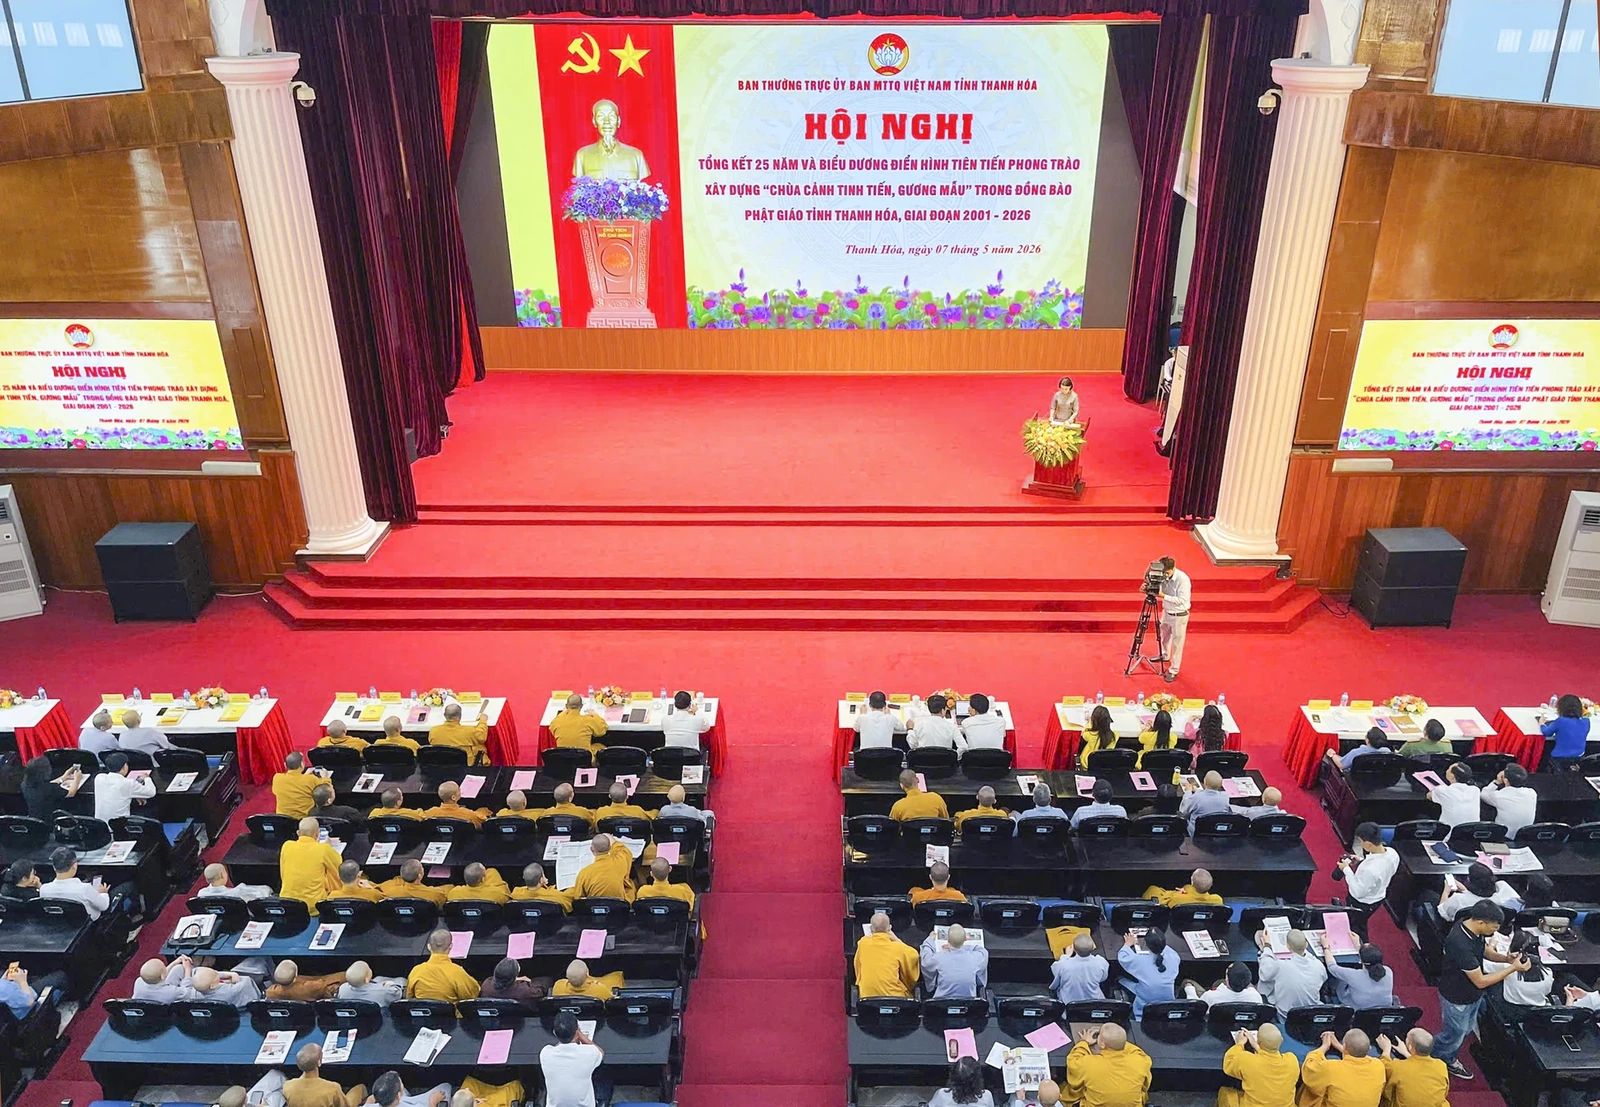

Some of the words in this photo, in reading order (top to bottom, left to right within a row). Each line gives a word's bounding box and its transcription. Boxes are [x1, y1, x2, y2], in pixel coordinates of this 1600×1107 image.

[738, 80, 759, 90] BAN
[762, 78, 802, 90] THƯỜNG
[805, 80, 830, 93] TRỰC
[833, 77, 846, 90] ỦY
[851, 80, 870, 90] BAN
[874, 80, 900, 92] MTTQ
[904, 79, 925, 93] VIỆT
[928, 80, 951, 91] NAM
[954, 78, 978, 91] TỈNH
[981, 80, 1014, 91] THANH
[1017, 78, 1038, 91] HÓA
[805, 108, 867, 145] HỘI
[881, 113, 974, 144] NGHỊ
[698, 154, 728, 170] TỔNG
[732, 155, 752, 170] KẾT
[755, 159, 769, 170] 25
[773, 157, 798, 170] NĂM
[802, 156, 816, 170] VÀ
[820, 155, 846, 170] BIỂU
[849, 159, 888, 170] DƯƠNG
[890, 155, 918, 170] ĐIỂN
[921, 157, 949, 170] HÌNH
[952, 157, 977, 170] TIÊN
[980, 155, 1005, 170] TIẾN
[1008, 159, 1048, 170] PHONG
[1050, 157, 1080, 170] TRÀO
[705, 182, 726, 196] XÂY
[730, 183, 760, 198] DỰNG
[763, 182, 801, 196] “CHÙA
[804, 182, 834, 196] CẢNH
[837, 185, 864, 196] TINH
[866, 181, 895, 197] TIẾN,
[898, 184, 937, 196] GƯƠNG
[940, 181, 972, 196] MẪU”
[975, 185, 1012, 196] TRONG
[1015, 181, 1047, 196] ĐỒNG
[1049, 183, 1072, 196] BÀO
[745, 208, 774, 223] PHẬT
[777, 208, 803, 221] GIÁO
[806, 207, 832, 221] TỈNH
[835, 210, 872, 221] THANH
[875, 207, 902, 224] HÓA,
[904, 209, 927, 221] GIAI
[930, 209, 961, 223] ĐOẠN
[963, 209, 991, 221] 2001
[1003, 209, 1031, 221] 2026
[845, 245, 877, 254] Thanh
[880, 245, 905, 255] Hóa,
[908, 246, 933, 257] ngày
[935, 245, 948, 254] 07
[950, 245, 979, 256] tháng
[982, 245, 989, 254] 5
[991, 246, 1013, 254] năm
[1017, 244, 1041, 254] 2026
[52, 364, 81, 379] HỘI
[84, 366, 126, 379] NGHỊ
[1457, 365, 1486, 380] HỘI
[1490, 367, 1532, 380] NGHỊ
